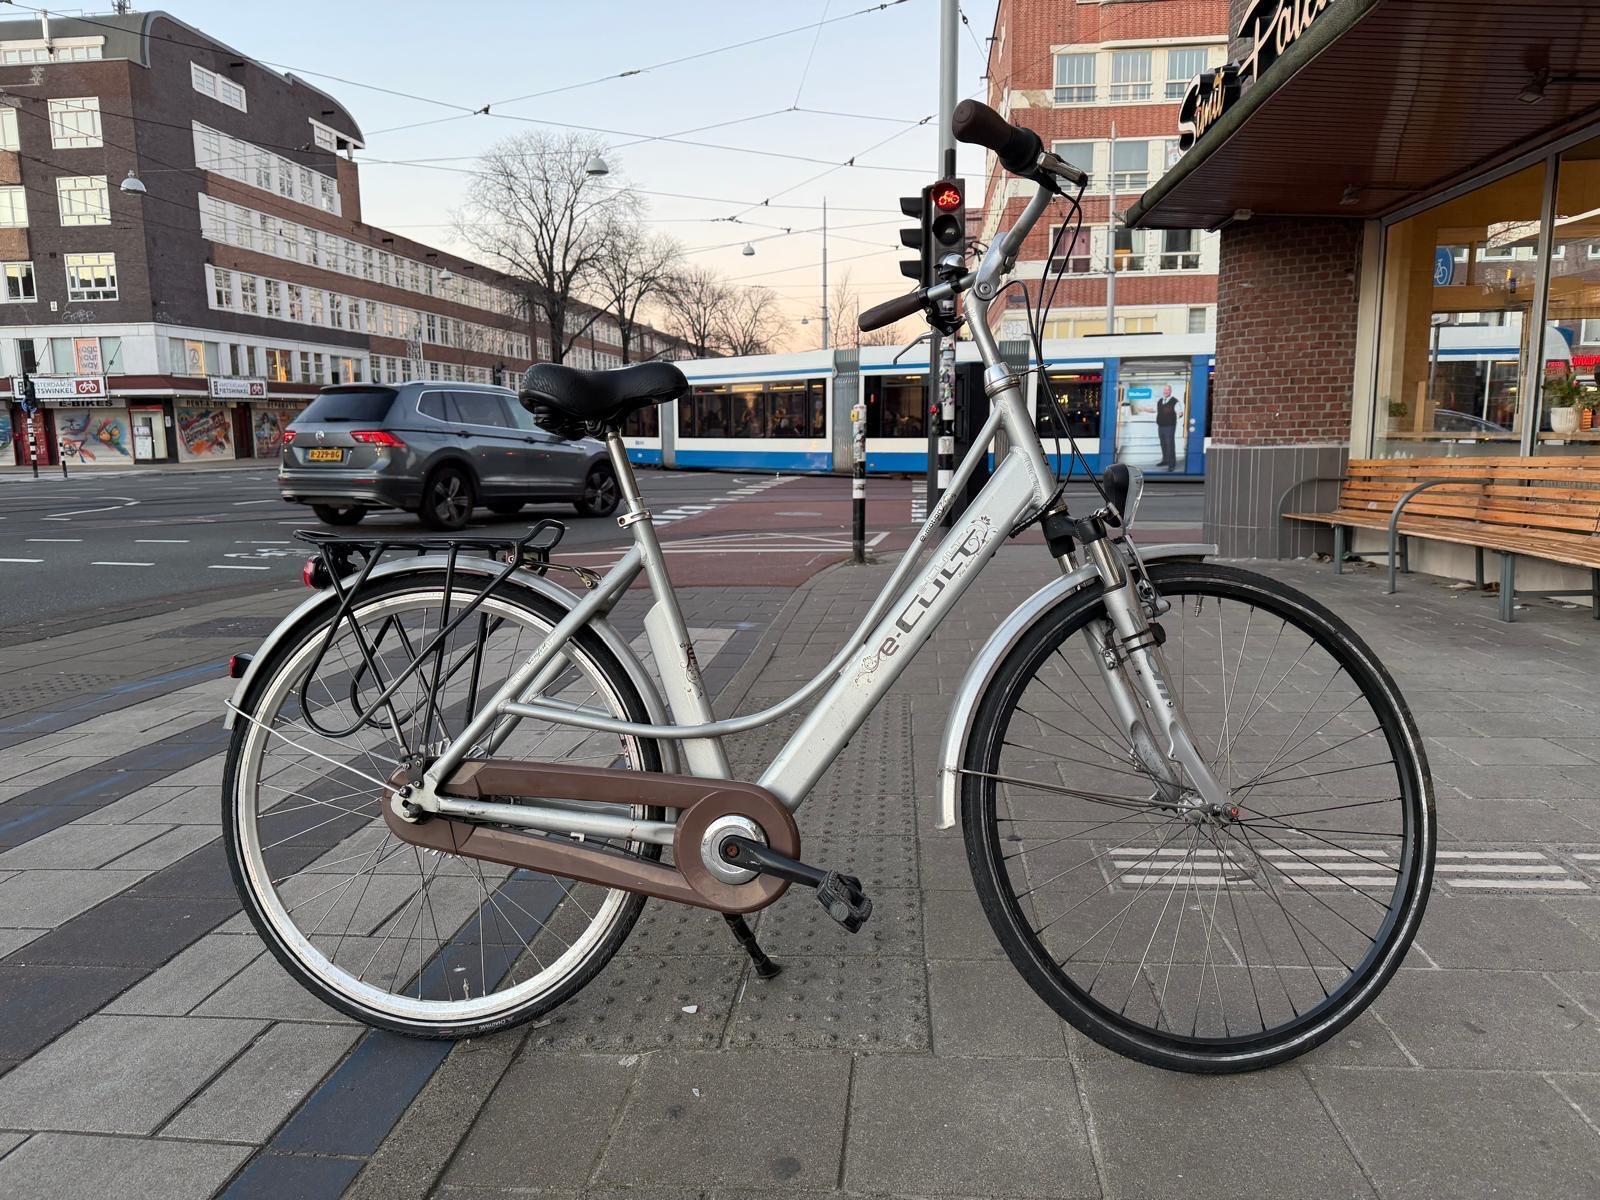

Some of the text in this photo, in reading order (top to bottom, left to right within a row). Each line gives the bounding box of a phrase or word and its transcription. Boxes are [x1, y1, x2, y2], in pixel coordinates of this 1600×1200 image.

[1178, 0, 1327, 158] Simit Pala
[79, 345, 98, 354] oga
[80, 361, 98, 371] way
